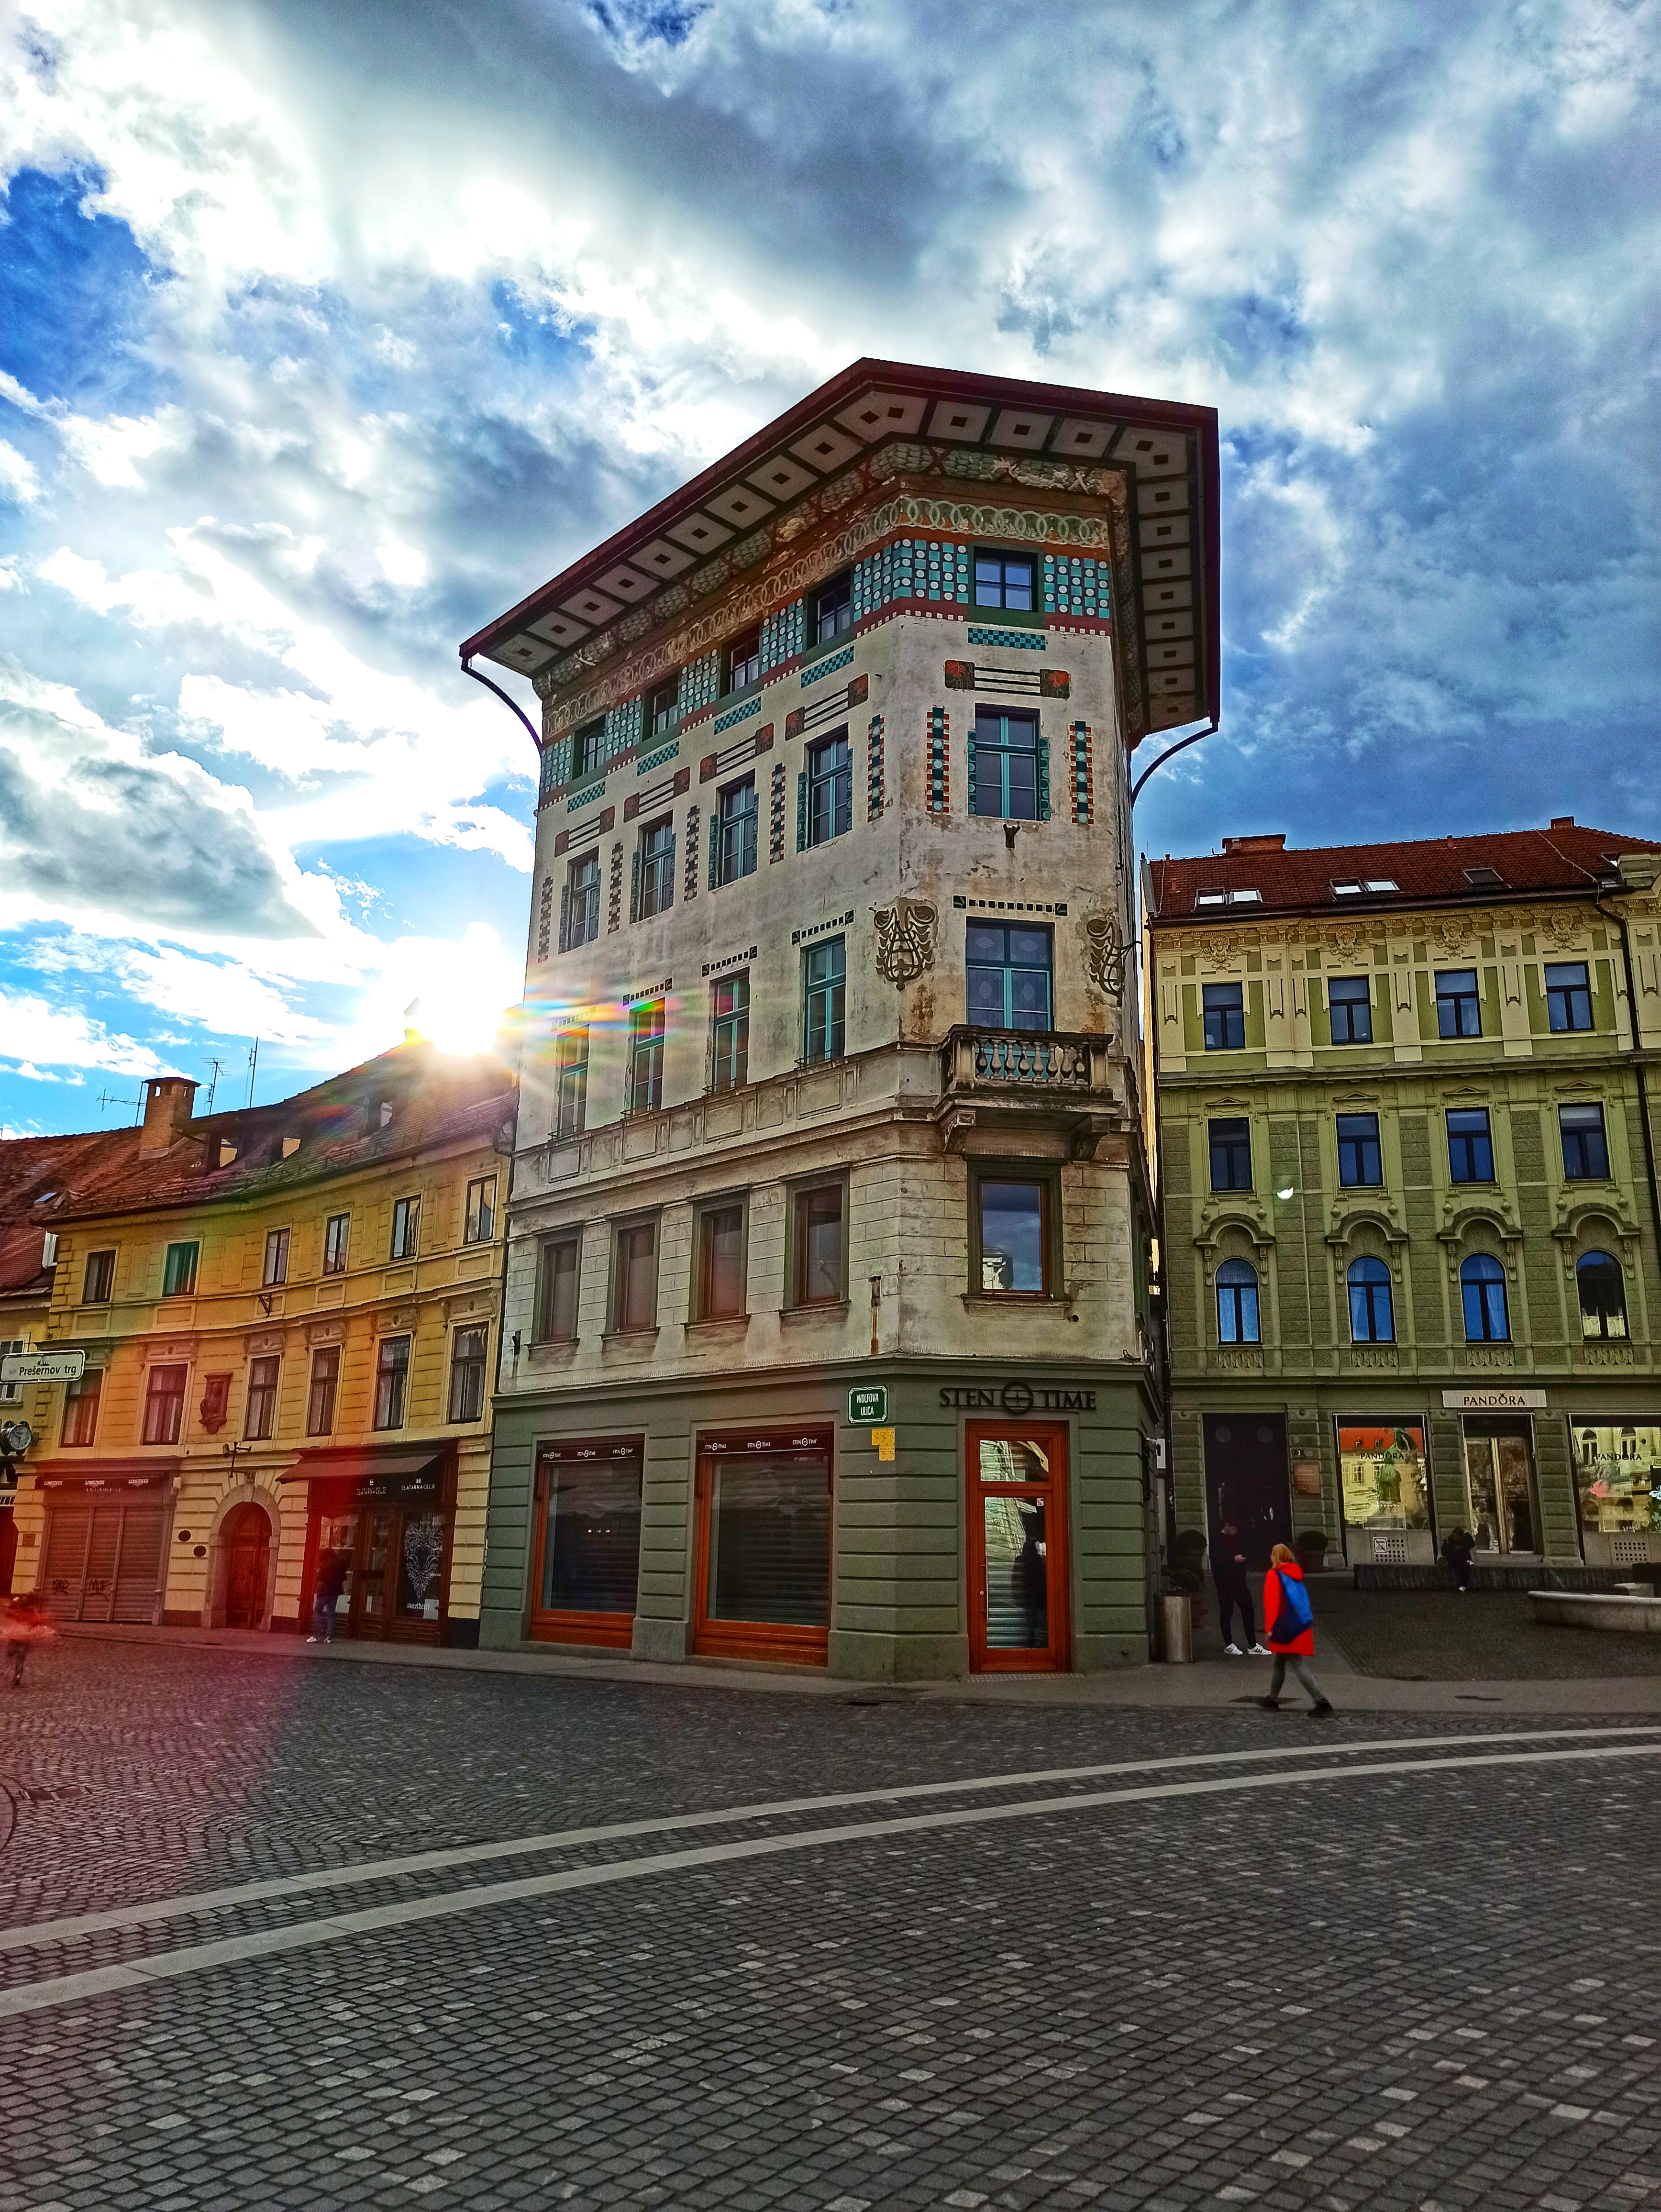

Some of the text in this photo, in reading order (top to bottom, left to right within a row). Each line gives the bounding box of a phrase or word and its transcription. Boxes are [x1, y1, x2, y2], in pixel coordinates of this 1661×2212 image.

[19, 1365, 77, 1376] Prešernov trg
[856, 1393, 879, 1403] WOLFOVA
[940, 1387, 1096, 1410] STEN TIME
[1463, 1393, 1526, 1405] PANDORA
[861, 1406, 874, 1416] ULICA
[1360, 1451, 1405, 1460] PANDORA
